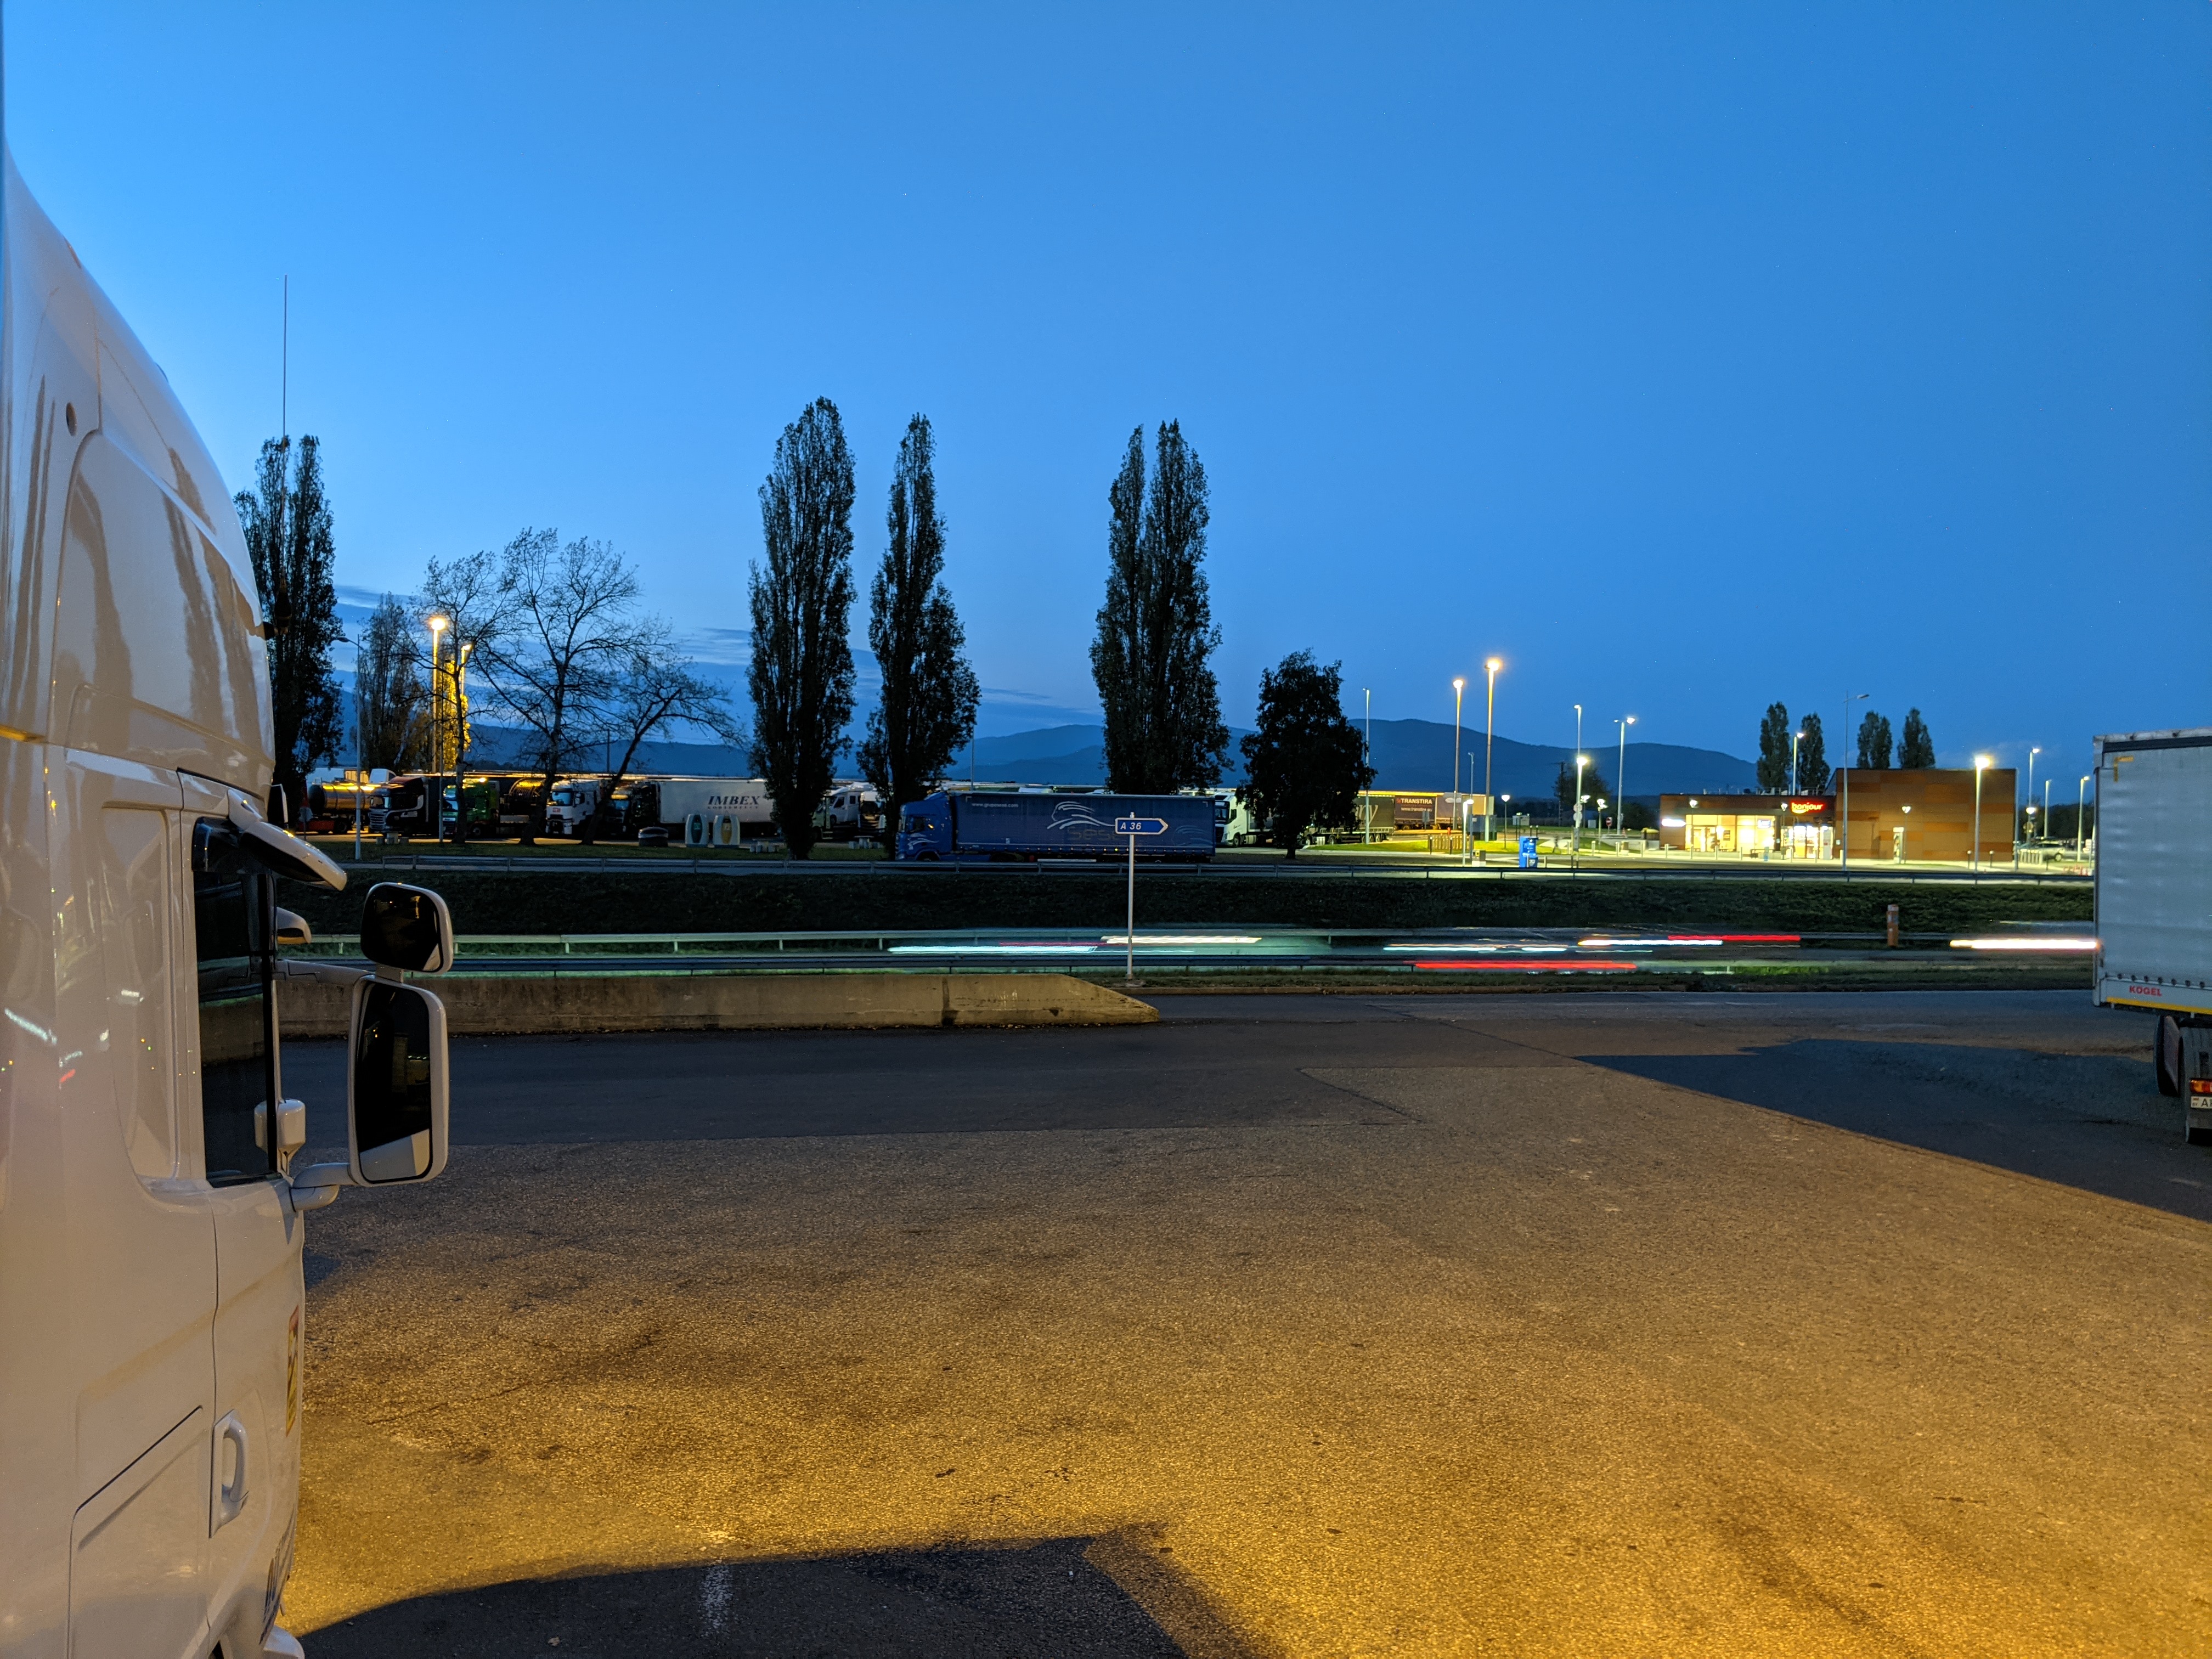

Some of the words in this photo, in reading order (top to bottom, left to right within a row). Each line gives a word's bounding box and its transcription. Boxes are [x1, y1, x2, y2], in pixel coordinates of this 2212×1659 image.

[708, 796, 760, 805] IMBEX
[1792, 803, 1823, 812] bonjour
[1129, 822, 1142, 830] 36
[2200, 1098, 2209, 1108] A
